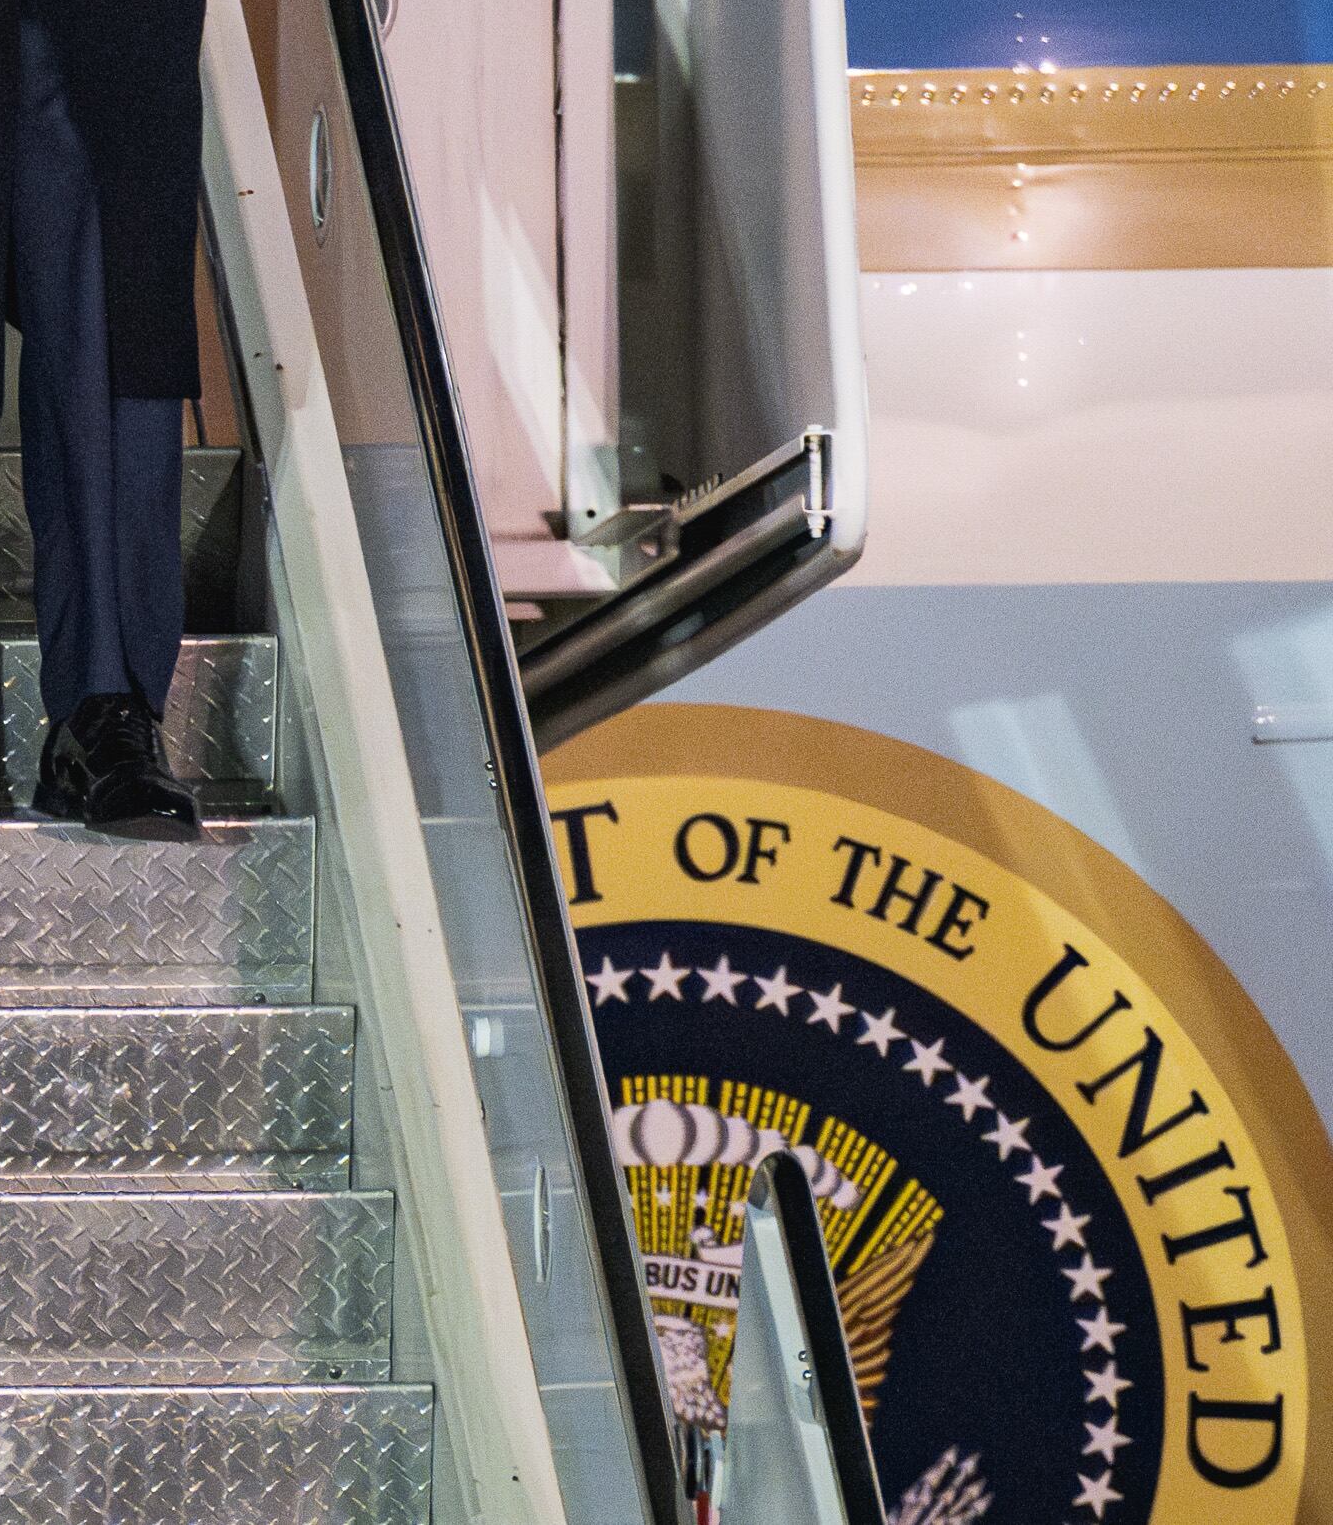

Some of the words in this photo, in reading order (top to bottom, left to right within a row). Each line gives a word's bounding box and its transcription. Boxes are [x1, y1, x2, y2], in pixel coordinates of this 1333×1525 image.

[673, 813, 792, 882] OF
[832, 836, 991, 963] THE
[1021, 944, 1285, 1492] UNITED
